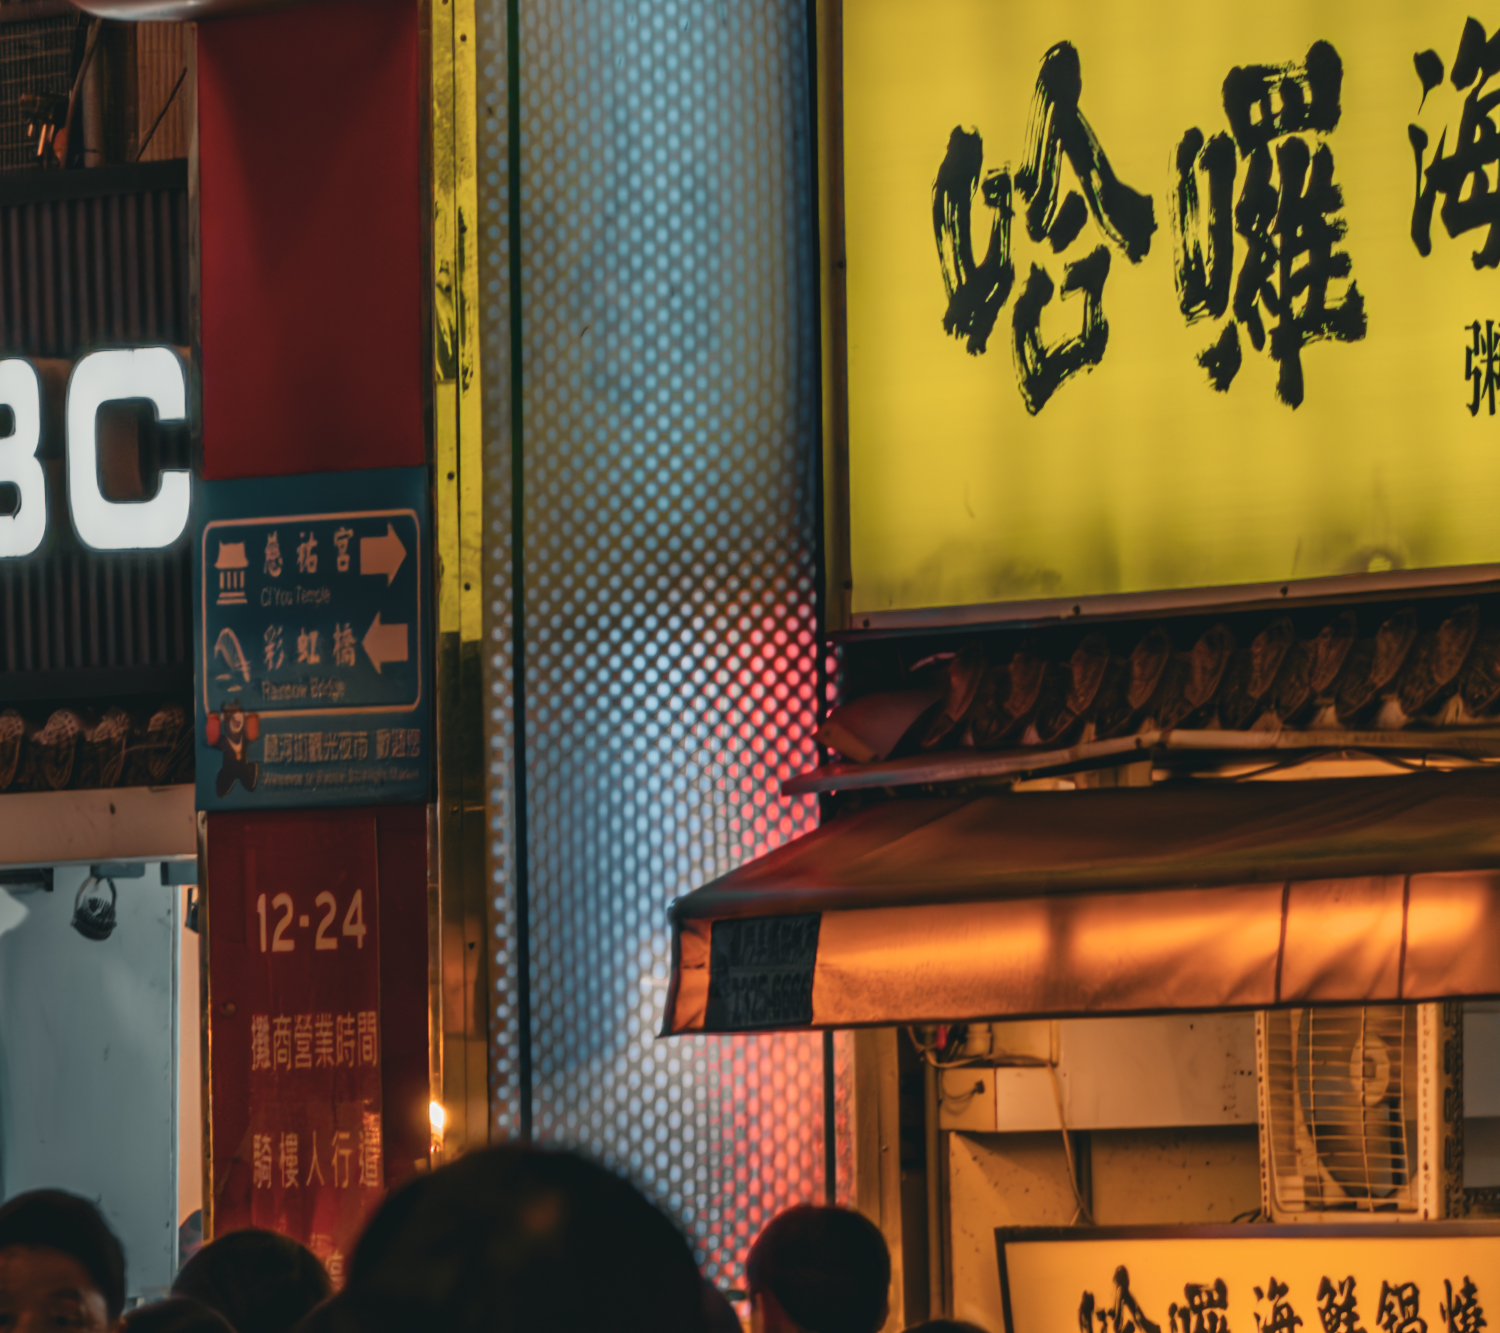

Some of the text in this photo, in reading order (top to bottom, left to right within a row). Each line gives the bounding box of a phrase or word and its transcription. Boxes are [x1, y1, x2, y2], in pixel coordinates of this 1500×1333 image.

[263, 622, 357, 672] 彩虹橋
[256, 889, 367, 953] 12-24
